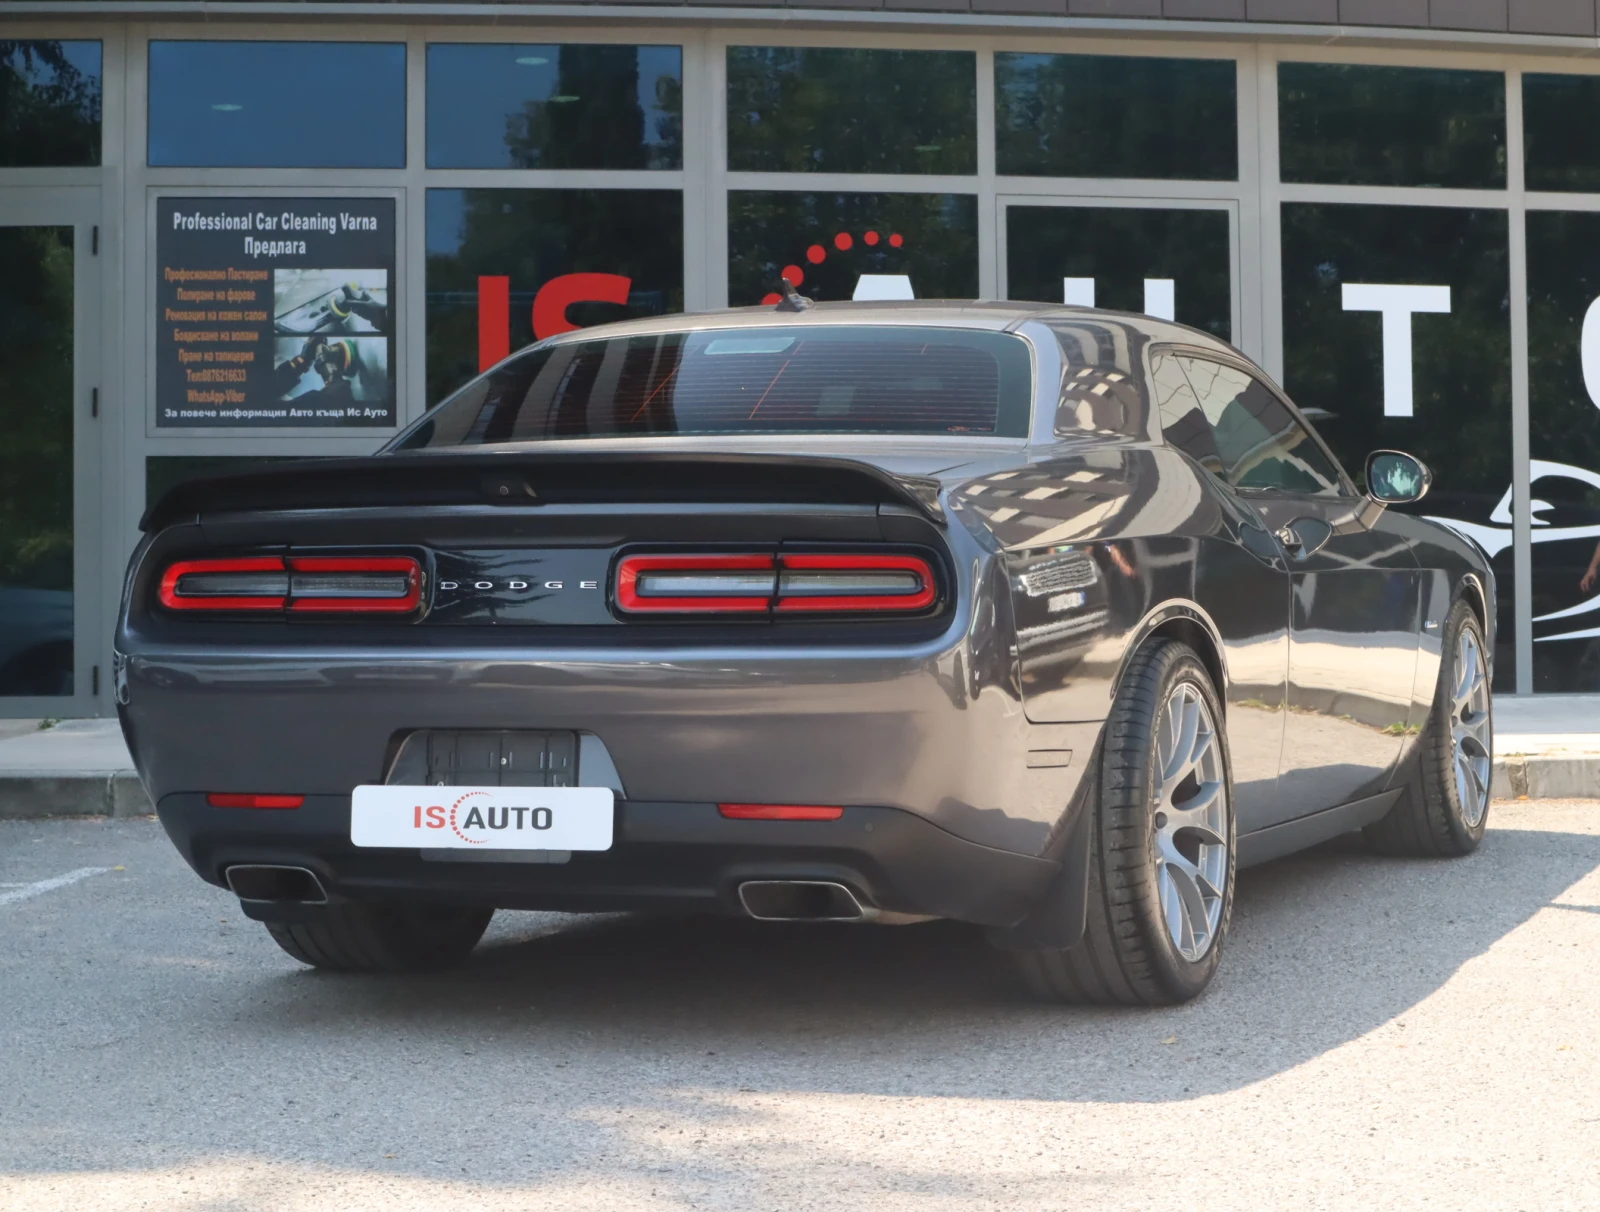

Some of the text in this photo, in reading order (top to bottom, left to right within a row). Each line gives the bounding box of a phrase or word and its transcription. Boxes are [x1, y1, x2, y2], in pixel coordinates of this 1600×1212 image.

[173, 212, 377, 234] Professional Car Cleaning Varna
[244, 236, 306, 258] Предлага
[165, 267, 226, 284] Професионално
[216, 291, 225, 301] на
[227, 287, 256, 304] фарове
[207, 311, 217, 321] на
[244, 311, 267, 321] салон
[220, 331, 230, 341] на
[178, 348, 203, 364] Пране
[203, 352, 214, 362] на
[164, 408, 388, 419] За повече информация Авто къща Ис Ауто
[440, 580, 599, 591] DODGE
[414, 806, 553, 830] IS AUTO
